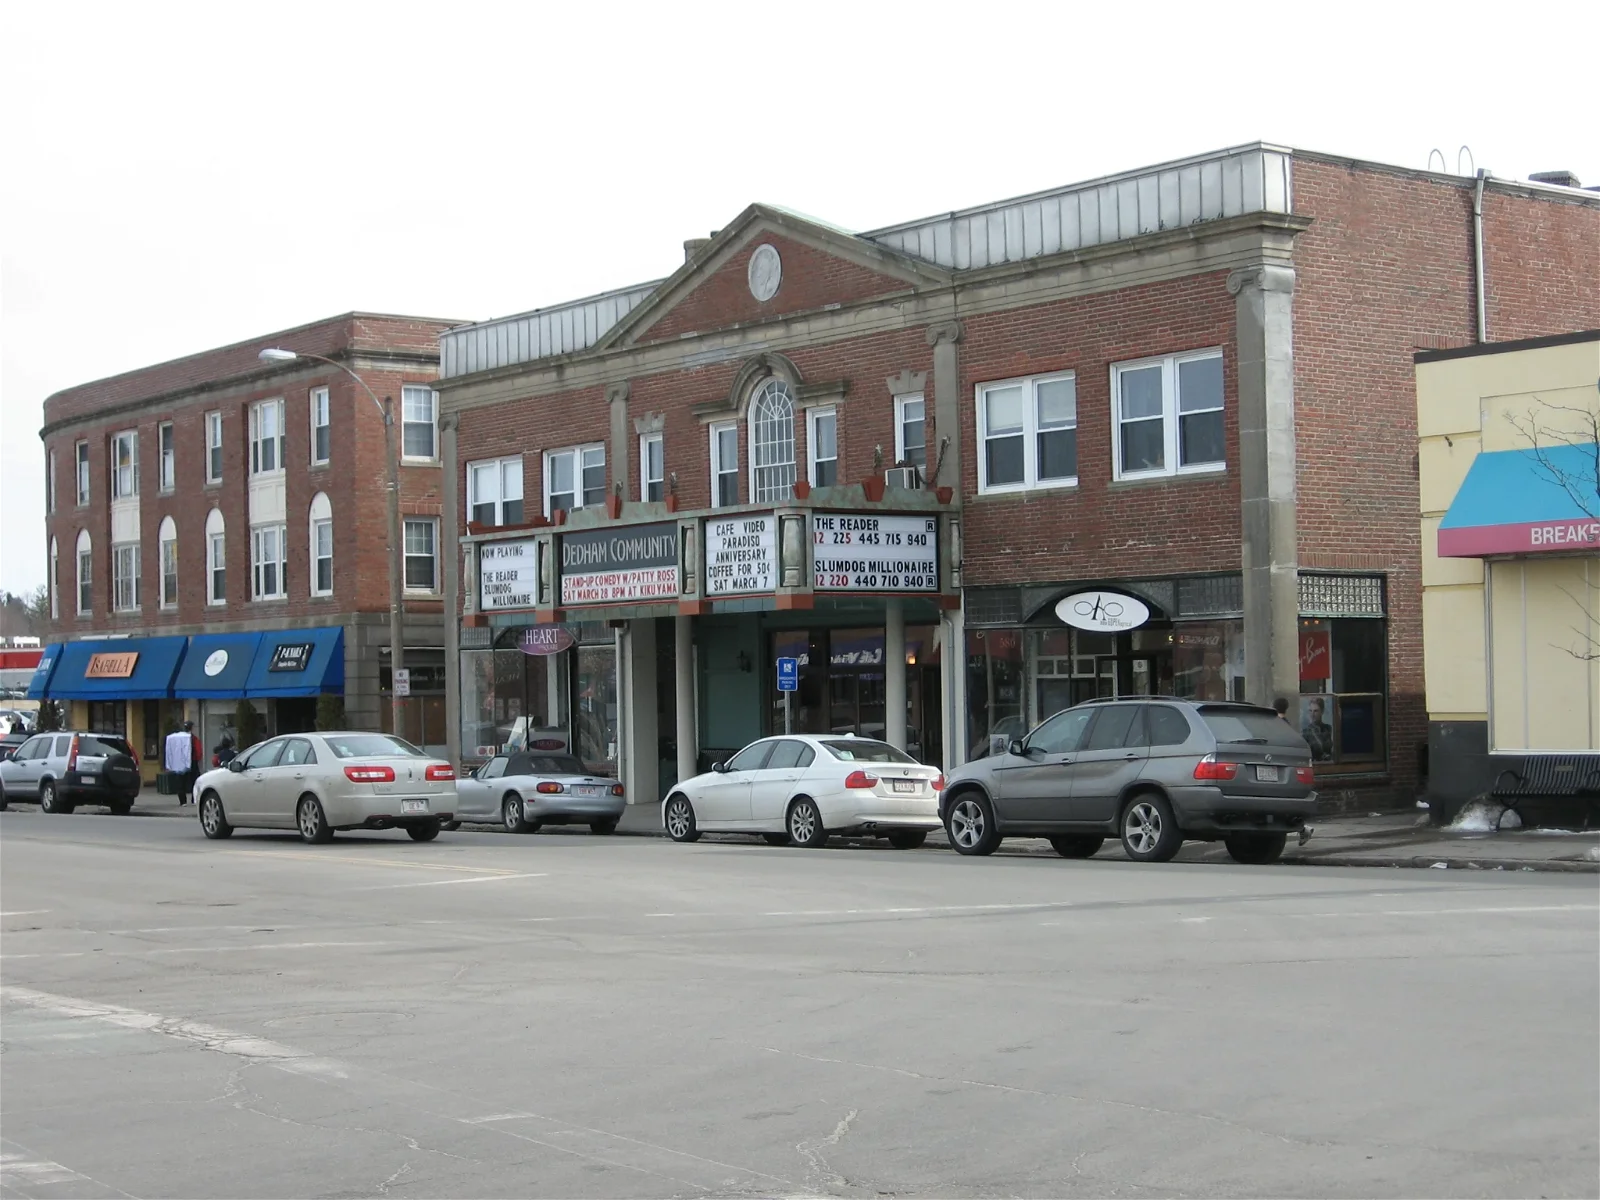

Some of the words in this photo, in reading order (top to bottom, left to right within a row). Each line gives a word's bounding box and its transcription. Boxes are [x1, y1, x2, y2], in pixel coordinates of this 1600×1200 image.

[716, 523, 734, 536] CAFE
[743, 520, 765, 533] VIDEO
[815, 518, 834, 530] THE
[839, 518, 879, 531] READER
[814, 532, 824, 544] 12
[833, 532, 851, 544] 225
[859, 532, 880, 545] 445
[885, 533, 901, 545] 715
[907, 534, 927, 546] 940
[1531, 523, 1600, 545] BREAKF
[722, 535, 760, 549] PARADISO
[481, 546, 496, 559] NOW
[497, 545, 523, 558] PLAYING
[563, 542, 608, 567] DEDHAM
[610, 534, 677, 563] COMMUNITY
[715, 548, 767, 564] ANNIVERSARY
[708, 565, 733, 578] COFFEE
[737, 563, 752, 575] FOR
[815, 560, 866, 573] SLUMDOG
[868, 561, 934, 574] MILLIONAIRE
[483, 573, 494, 583] THE
[495, 571, 518, 583] READER
[595, 573, 622, 587] COMEDY
[622, 571, 655, 584] W/PATTY
[657, 569, 675, 582] ROSS
[714, 579, 728, 591] SAT
[732, 577, 757, 590] MARCH
[763, 576, 768, 588] 7
[815, 574, 825, 586] 12
[830, 574, 849, 587] 220
[855, 575, 877, 587] 440
[882, 575, 899, 587] 710
[904, 575, 923, 587] 940
[484, 584, 512, 595] SLUMDOG
[563, 590, 576, 602] SAT
[577, 588, 599, 601] MARCH
[600, 587, 609, 599] 28
[612, 586, 626, 598] 8PM
[627, 585, 637, 597] AT
[493, 594, 531, 607] MILLIONAIRE
[525, 629, 559, 645] HEART
[91, 657, 130, 674] ISABELLA
